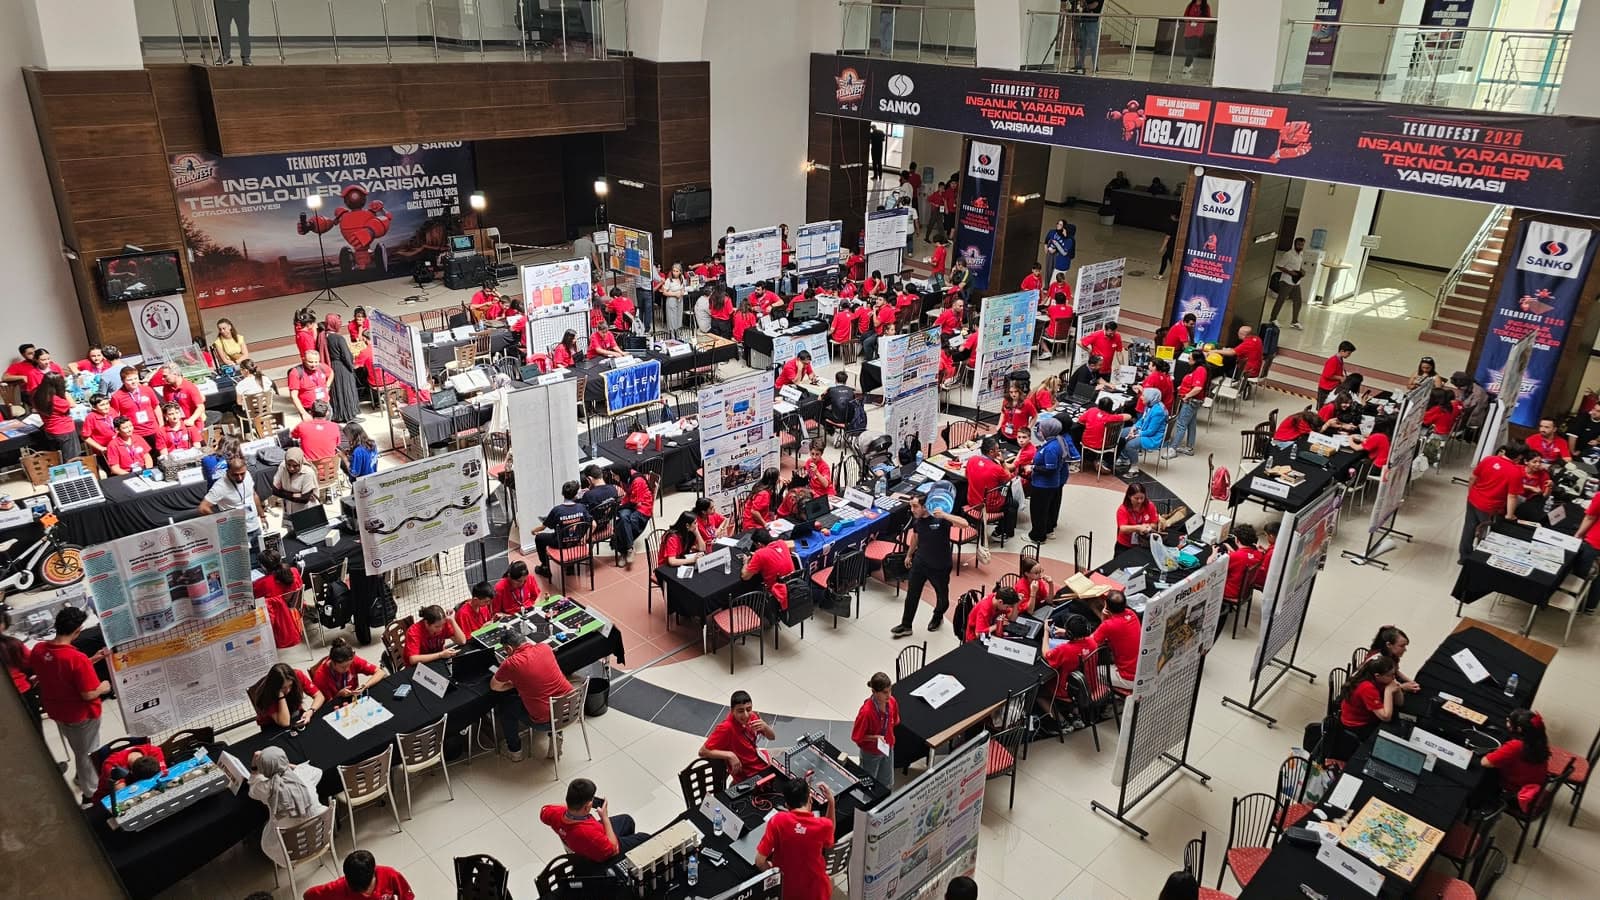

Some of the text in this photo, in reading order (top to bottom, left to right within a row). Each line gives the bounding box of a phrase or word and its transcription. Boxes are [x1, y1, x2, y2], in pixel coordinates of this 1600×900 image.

[990, 83, 1060, 99] TEKNOFEST 2026
[879, 98, 921, 116] SANKO
[1021, 101, 1085, 117] YARARINA
[1144, 118, 1203, 149] 189.701
[1231, 128, 1257, 155] 101
[1402, 122, 1523, 146] TEKNOFEST 2026
[286, 152, 367, 171] TEKNOFEST 2026
[1452, 146, 1565, 170] YARARINA
[325, 163, 426, 183] YARARINA
[972, 165, 996, 176] SANKO
[1202, 204, 1235, 216] SANKO
[1526, 255, 1573, 271] SANKO
[1500, 308, 1543, 322] TEKNOFEST
